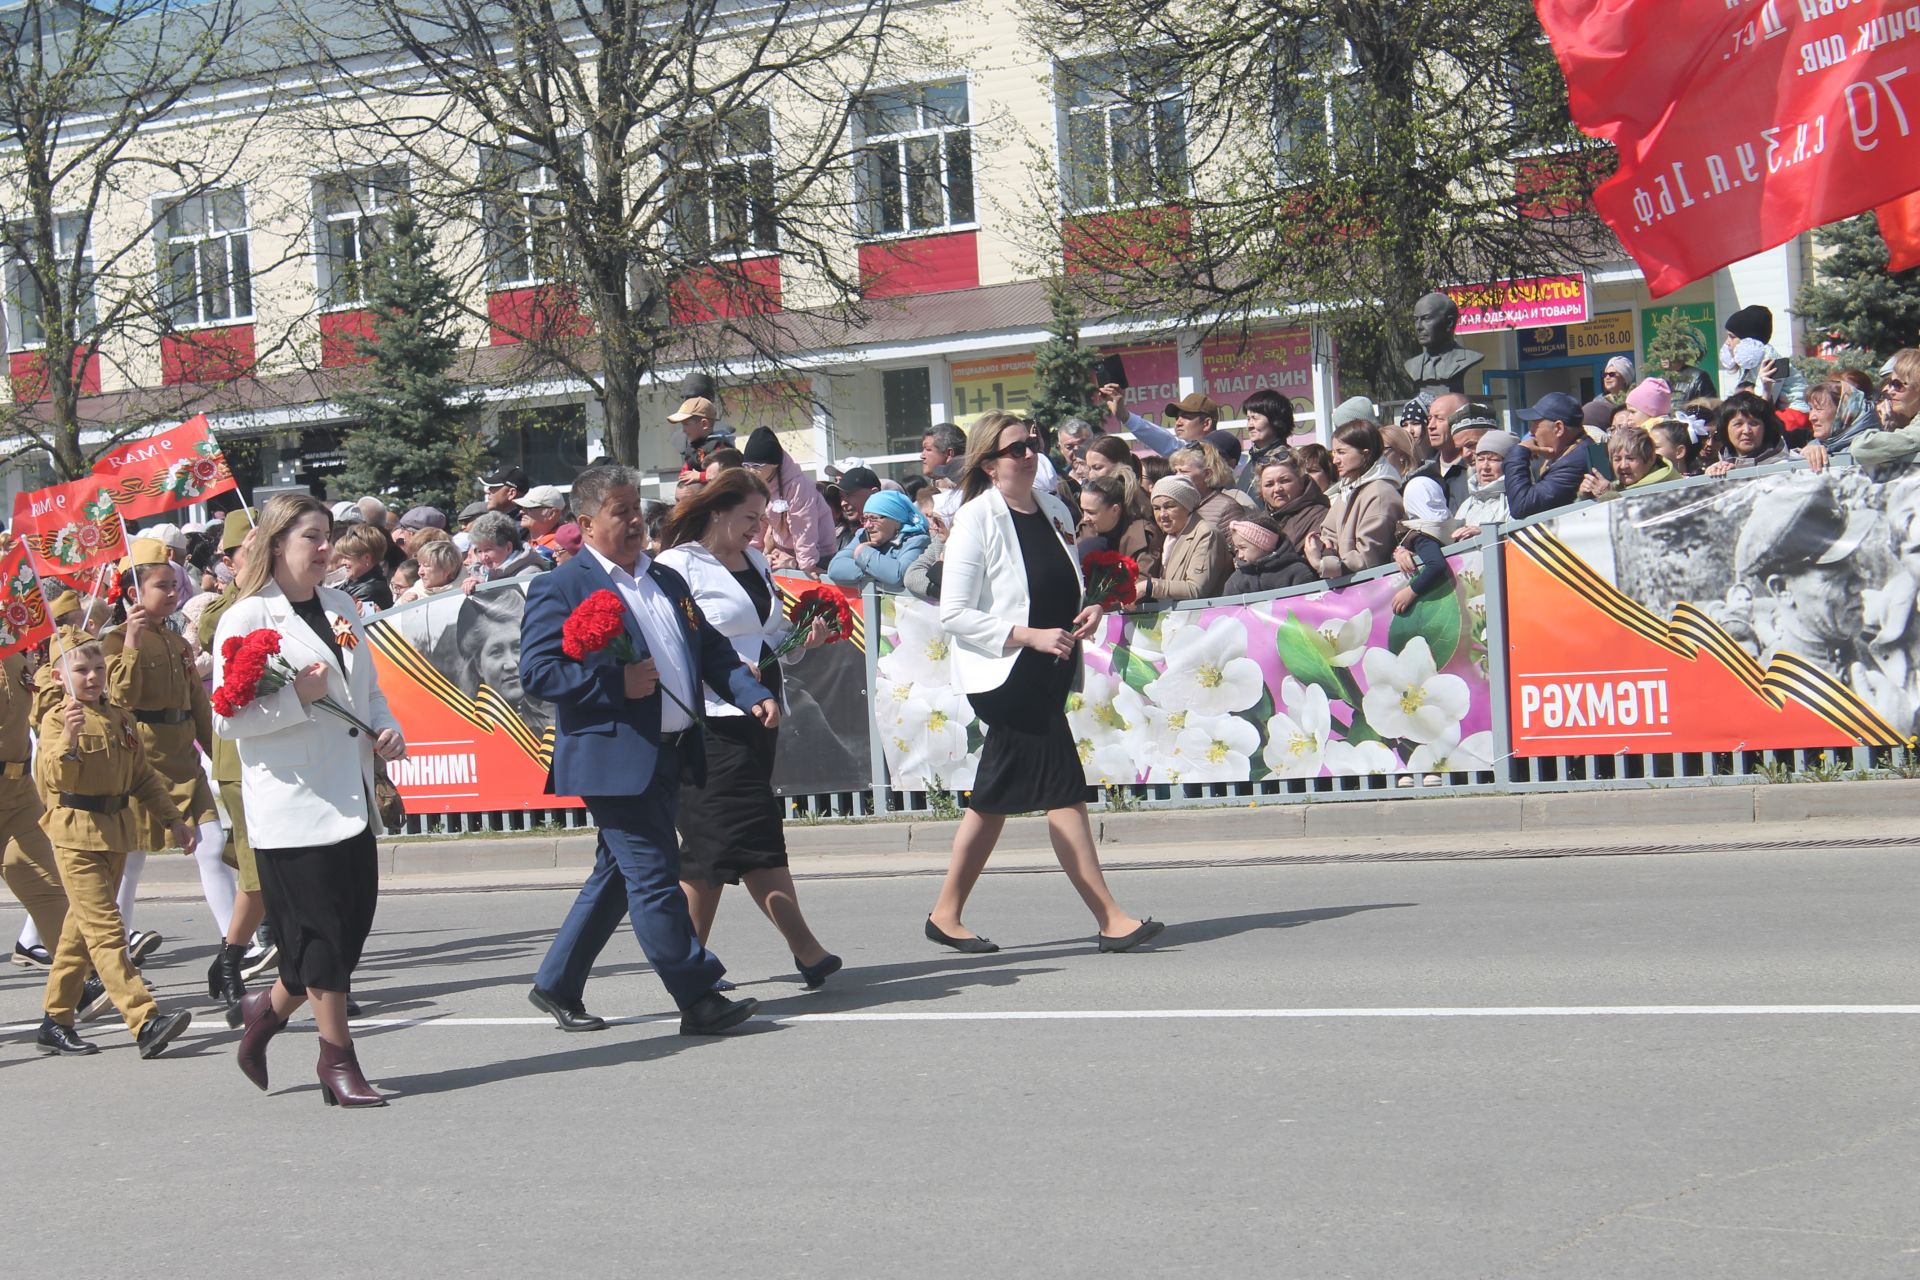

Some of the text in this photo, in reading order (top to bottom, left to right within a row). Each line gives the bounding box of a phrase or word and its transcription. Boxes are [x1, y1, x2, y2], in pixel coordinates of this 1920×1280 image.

[1457, 304, 1581, 325] КАЯ ОДЕЖДА И ТОВАРЫ
[1577, 330, 1631, 348] 8.00-18.00
[1216, 369, 1307, 393] МАГАЗИН
[1521, 680, 1668, 728] РӘХМӘТ!
